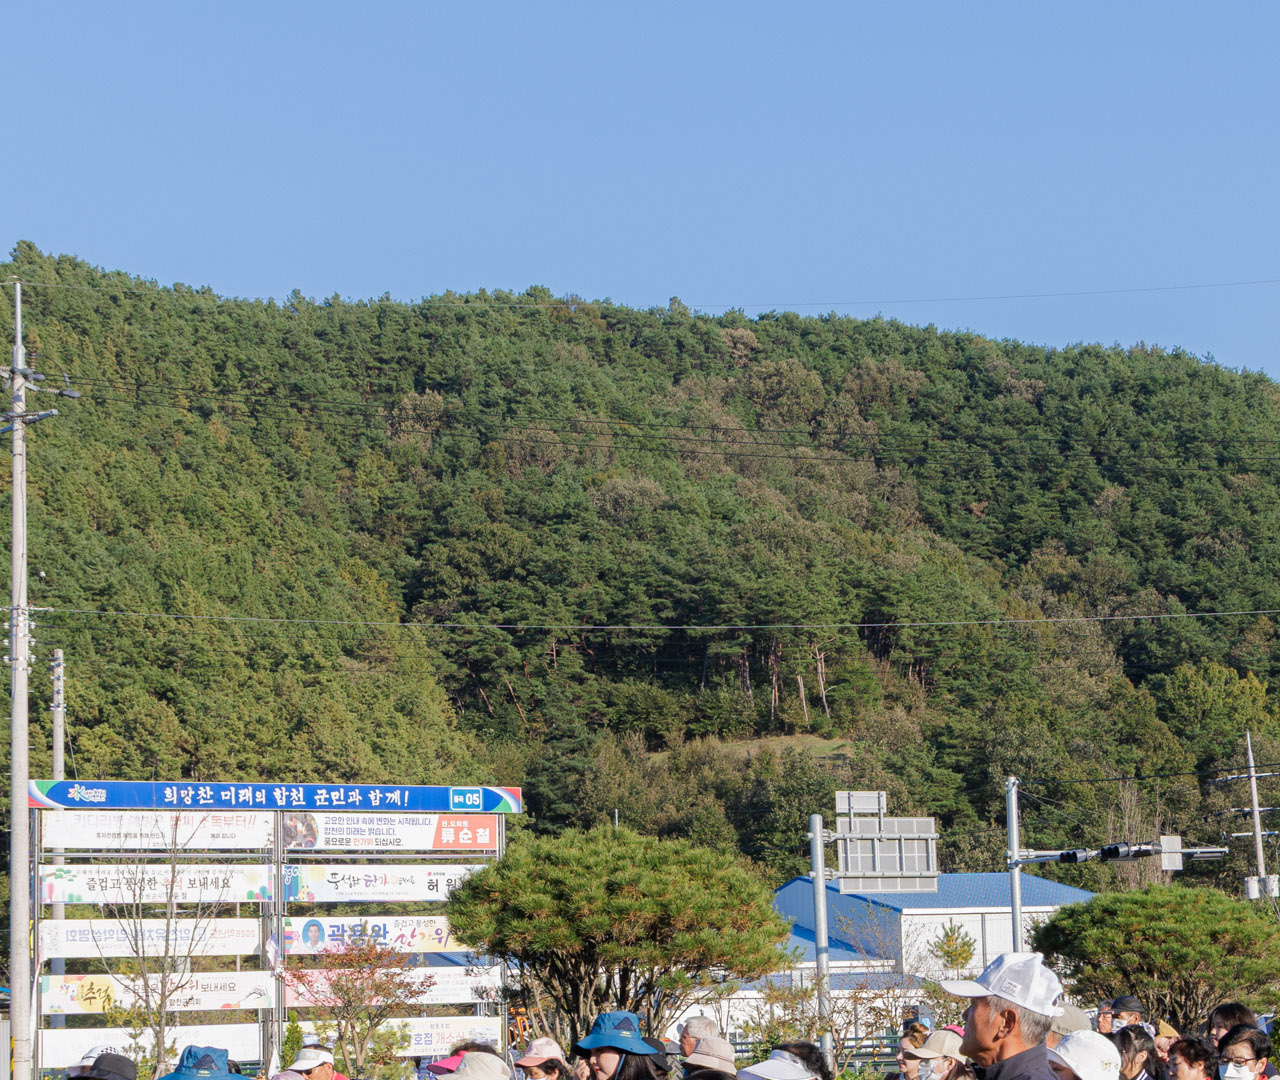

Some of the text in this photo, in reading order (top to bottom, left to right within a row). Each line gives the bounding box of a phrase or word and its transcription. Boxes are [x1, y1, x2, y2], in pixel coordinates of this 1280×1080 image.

[164, 787, 409, 806] 희망찬 미래의 합천 군민과 함께!
[465, 793, 480, 805] 05
[346, 827, 367, 836] 미래는
[324, 837, 352, 846] 풍요로운
[86, 877, 121, 891] 즐겁고
[187, 876, 231, 890] 보내세요
[200, 983, 237, 993] 보내세요
